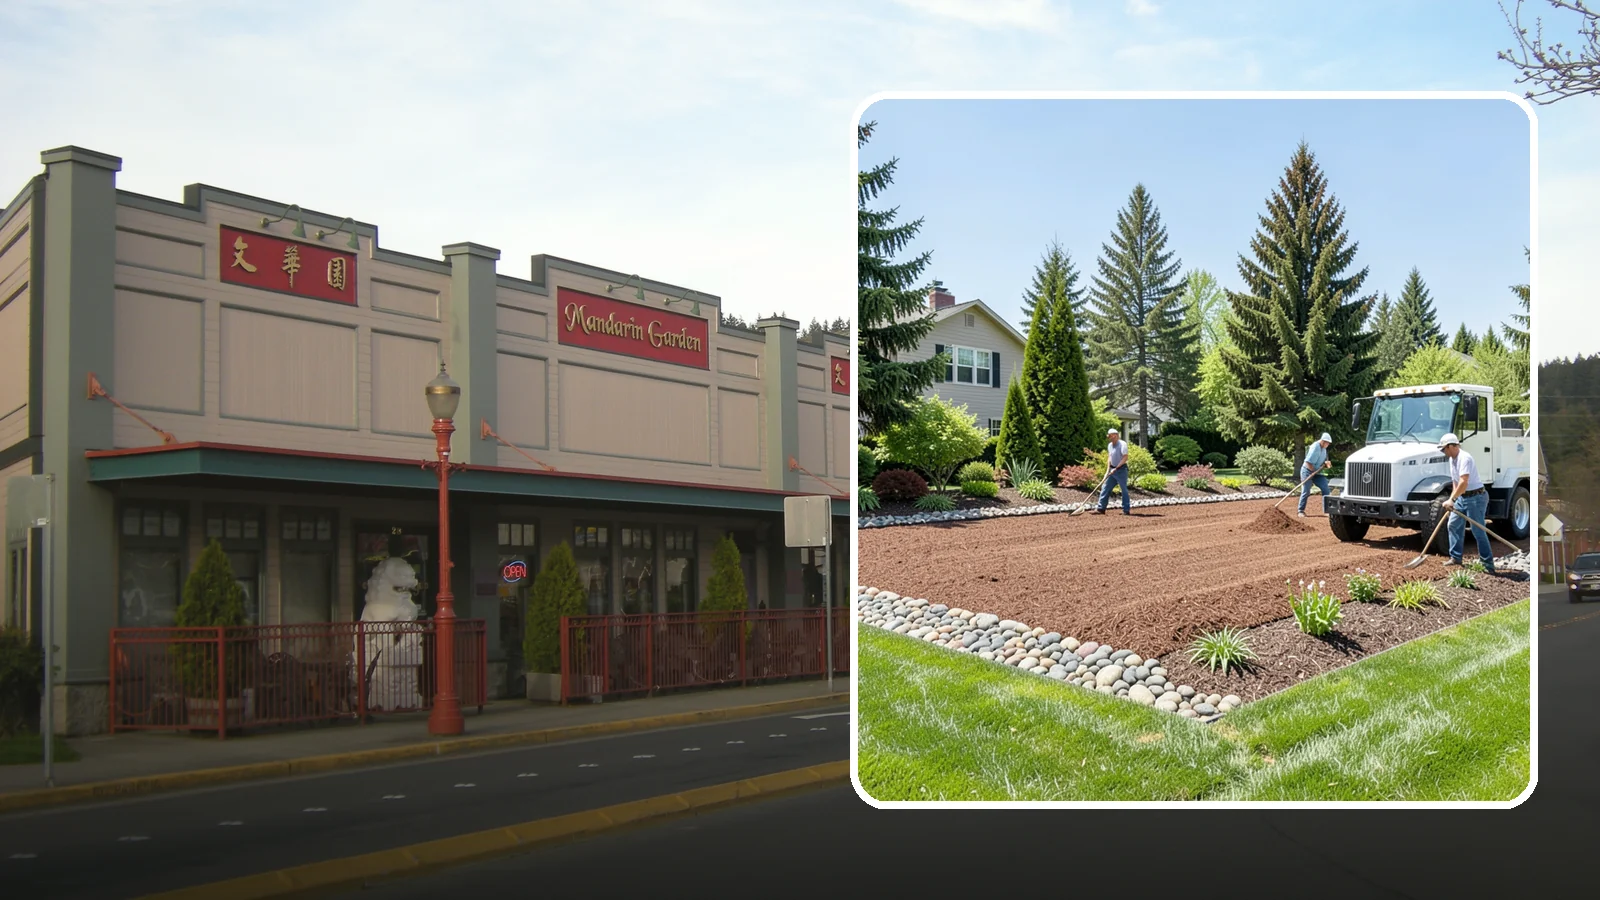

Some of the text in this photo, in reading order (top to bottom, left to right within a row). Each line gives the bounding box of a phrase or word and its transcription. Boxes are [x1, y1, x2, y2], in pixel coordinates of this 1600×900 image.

[231, 235, 346, 291] 文華園
[564, 302, 702, 352] Mandarin Garden
[503, 565, 527, 578] OPEN
